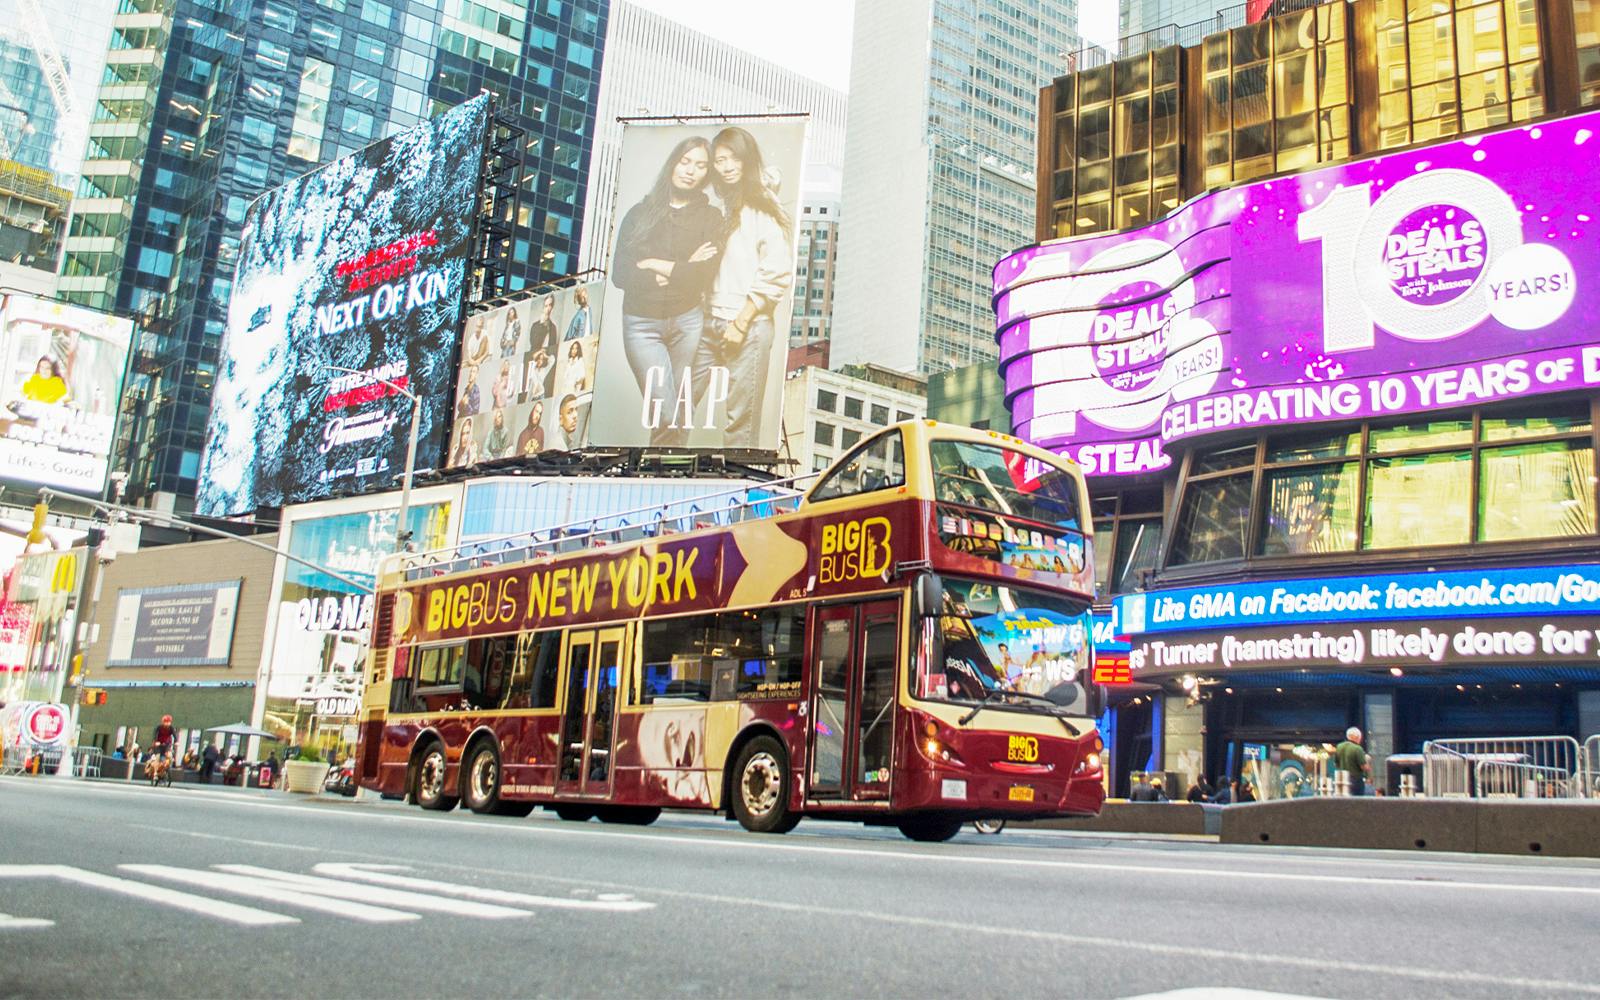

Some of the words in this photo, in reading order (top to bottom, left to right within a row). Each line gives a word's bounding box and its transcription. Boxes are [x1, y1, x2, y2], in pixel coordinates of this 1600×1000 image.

[1387, 220, 1483, 259] DEALS
[1298, 168, 1523, 353] 10
[1388, 245, 1483, 281] STEALS
[312, 294, 371, 339] NEXT
[371, 282, 406, 321] OF
[405, 269, 451, 311] KIN
[1427, 278, 1472, 297] Johnson
[1490, 273, 1569, 301] YEARS!
[1094, 296, 1177, 342] DEALS
[330, 359, 408, 395] STREAMING
[1174, 346, 1218, 381] YEARS!
[641, 366, 730, 429] GAP
[1161, 382, 1361, 441] CELEBRATING
[1368, 377, 1406, 411] 10
[1411, 358, 1531, 406] YEARS
[1535, 357, 1574, 384] OF
[52, 461, 94, 479] Good
[821, 520, 861, 555] BIG
[527, 562, 600, 618] NEW
[608, 547, 699, 610] YORK
[819, 552, 859, 584] BUS
[298, 595, 339, 632] OLD
[1152, 594, 1186, 623] Like
[1189, 591, 1235, 619] GMA
[1239, 593, 1266, 615] on
[1270, 583, 1381, 614] Facebook:
[1151, 639, 1218, 667] Turner
[1221, 628, 1365, 667] (hamstring)
[1370, 627, 1449, 662] likely
[1452, 625, 1536, 655] done
[1539, 623, 1592, 655] for
[317, 698, 337, 715] OLD
[1007, 748, 1026, 761] BUS
[1008, 735, 1026, 749] BIG
